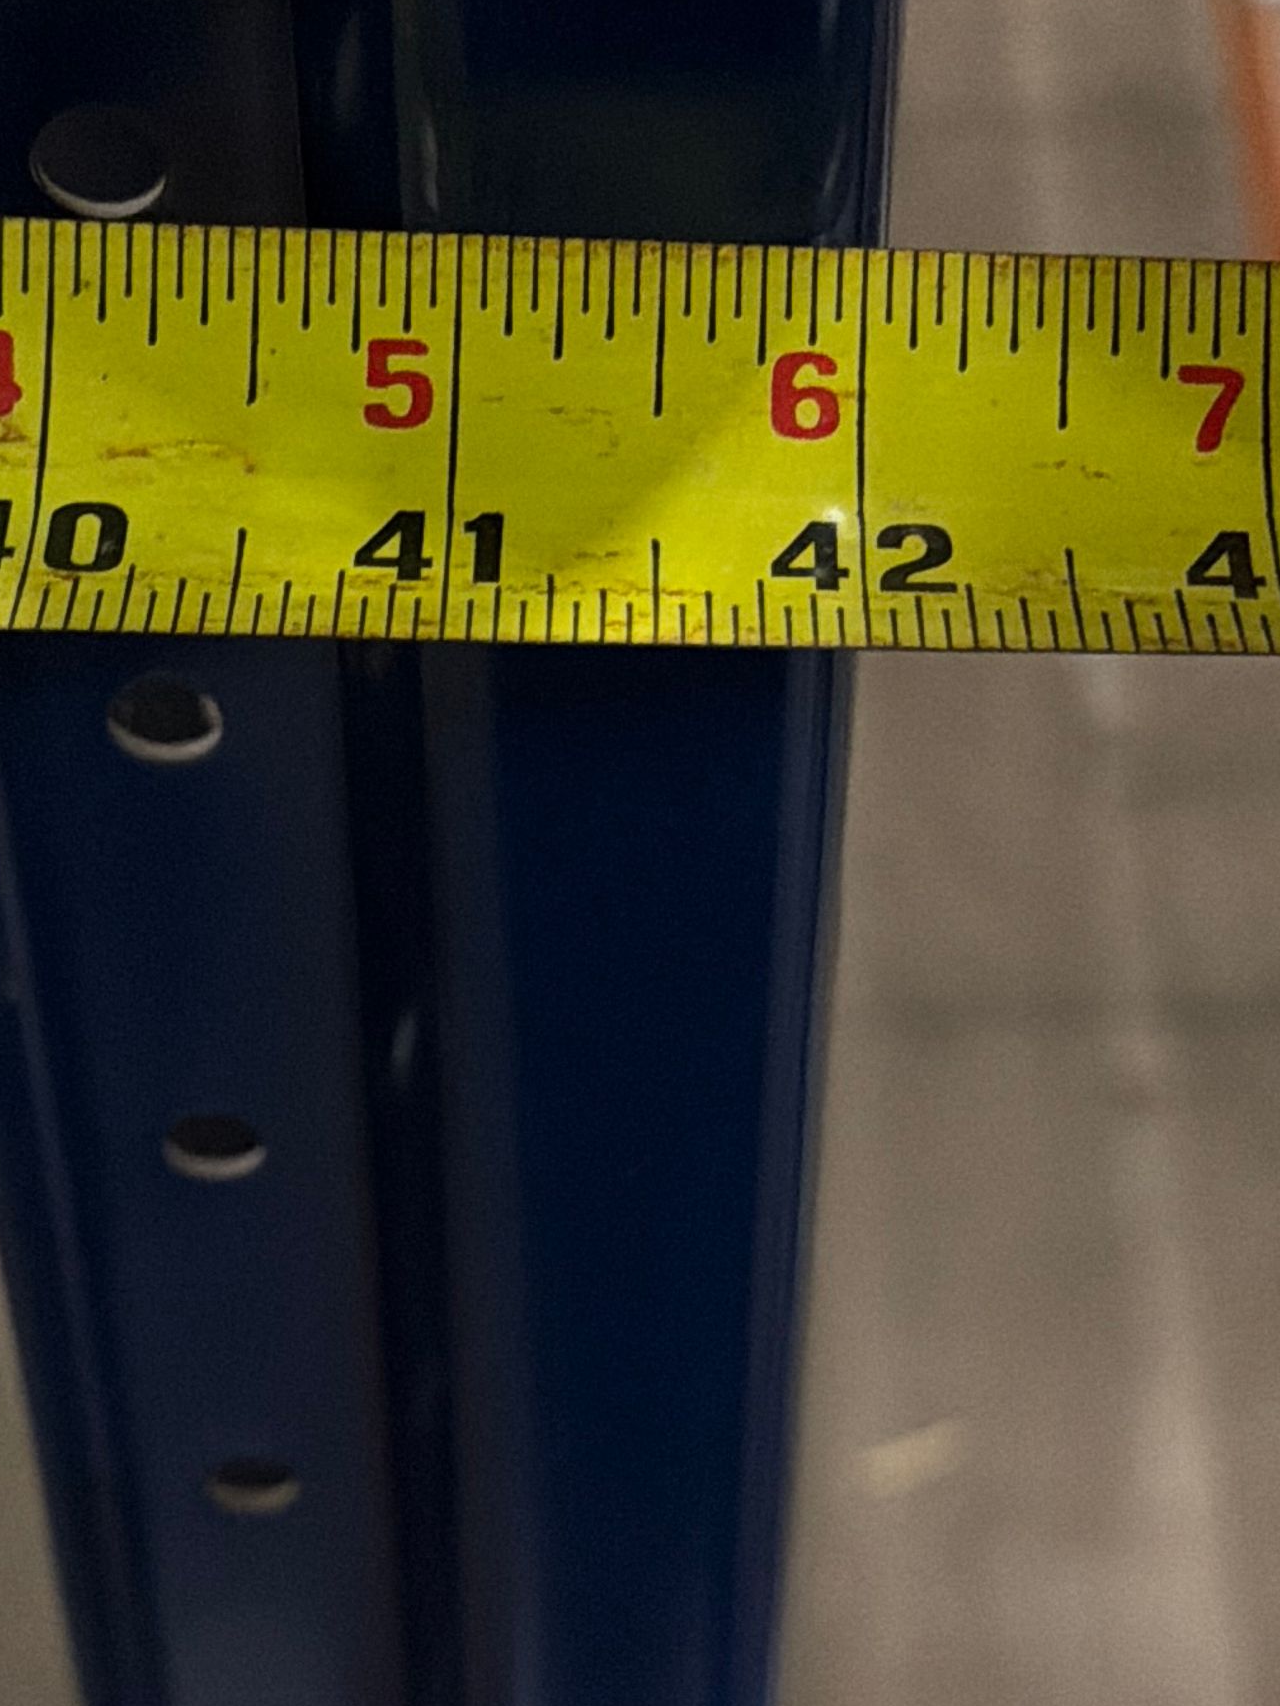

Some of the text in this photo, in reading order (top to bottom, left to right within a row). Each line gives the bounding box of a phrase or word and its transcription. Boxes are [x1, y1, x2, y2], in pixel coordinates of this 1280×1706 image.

[363, 338, 435, 429] 5
[770, 351, 840, 440] 6
[1175, 365, 1246, 454] 7
[353, 509, 505, 584] 41
[770, 520, 958, 593] 42
